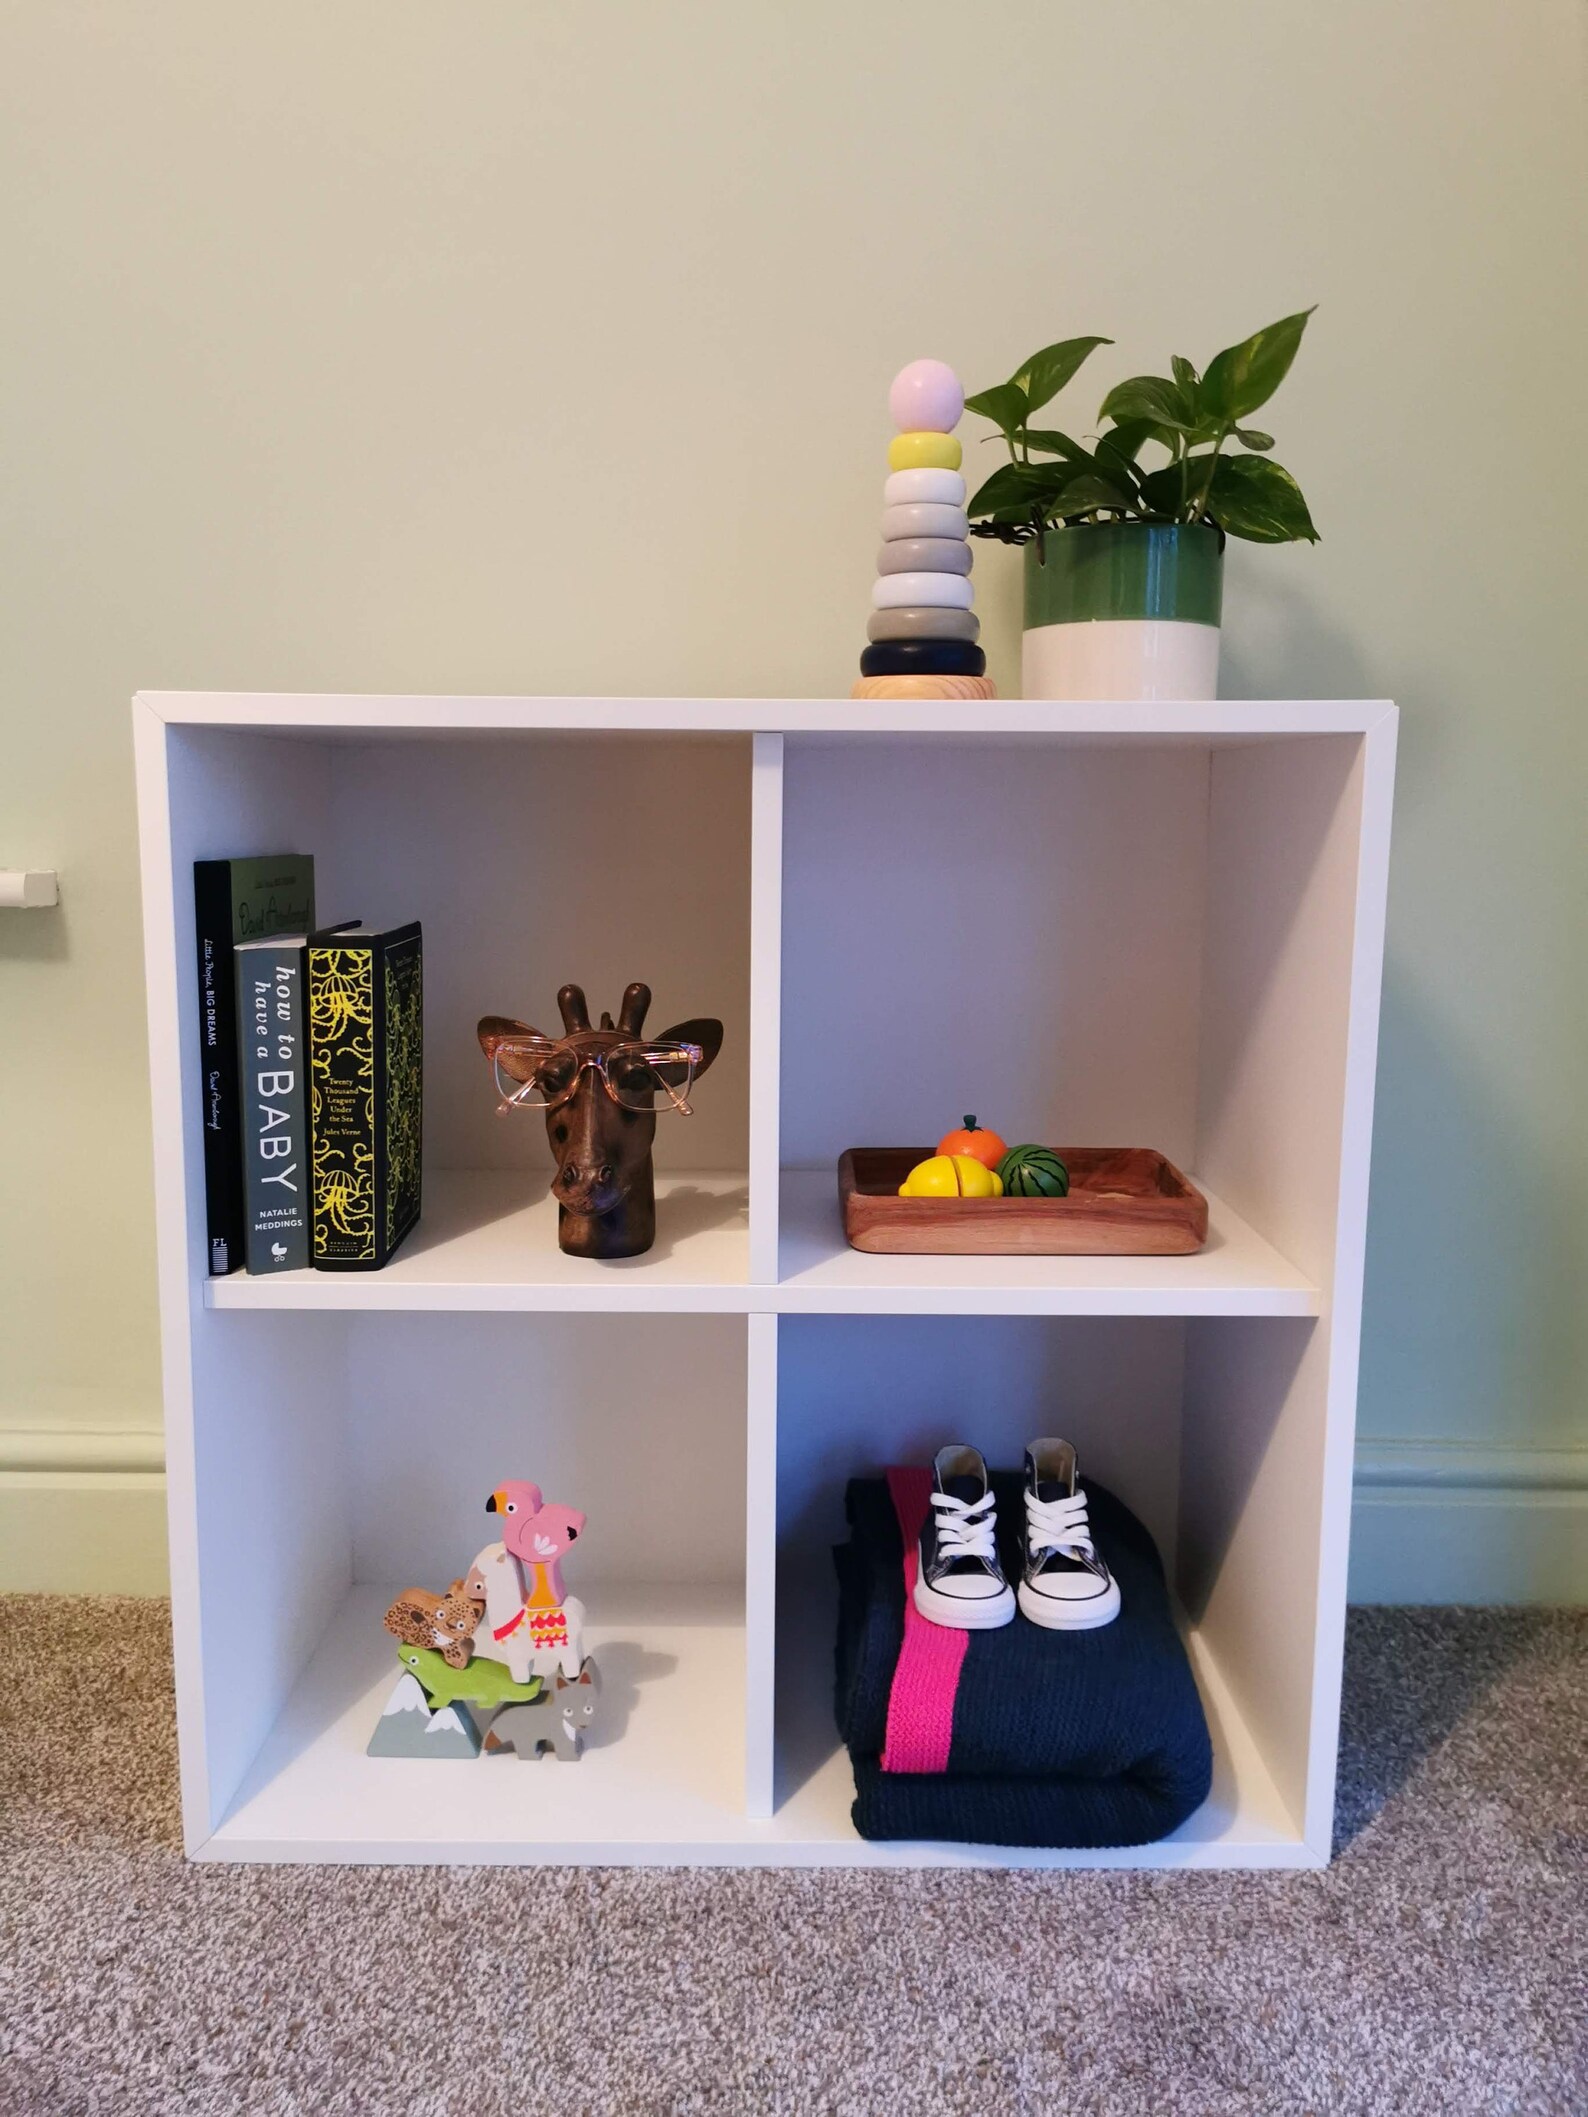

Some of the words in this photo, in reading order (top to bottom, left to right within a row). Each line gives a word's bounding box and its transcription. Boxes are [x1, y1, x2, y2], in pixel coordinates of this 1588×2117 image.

[206, 990, 215, 1006] BIG
[276, 966, 296, 1021] how
[254, 981, 271, 1036] have
[206, 1009, 216, 1046] DREAMS
[256, 1046, 269, 1059] a
[278, 1034, 295, 1060] to
[328, 1077, 353, 1087] Twenty
[323, 1086, 359, 1094] Thousand
[327, 1096, 356, 1105] Leagues
[257, 1070, 298, 1192] BABY
[323, 1128, 340, 1136] Jules
[260, 1208, 298, 1219] NATALIE
[254, 1219, 303, 1231] MEDDINGS
[212, 1238, 227, 1247] FL
